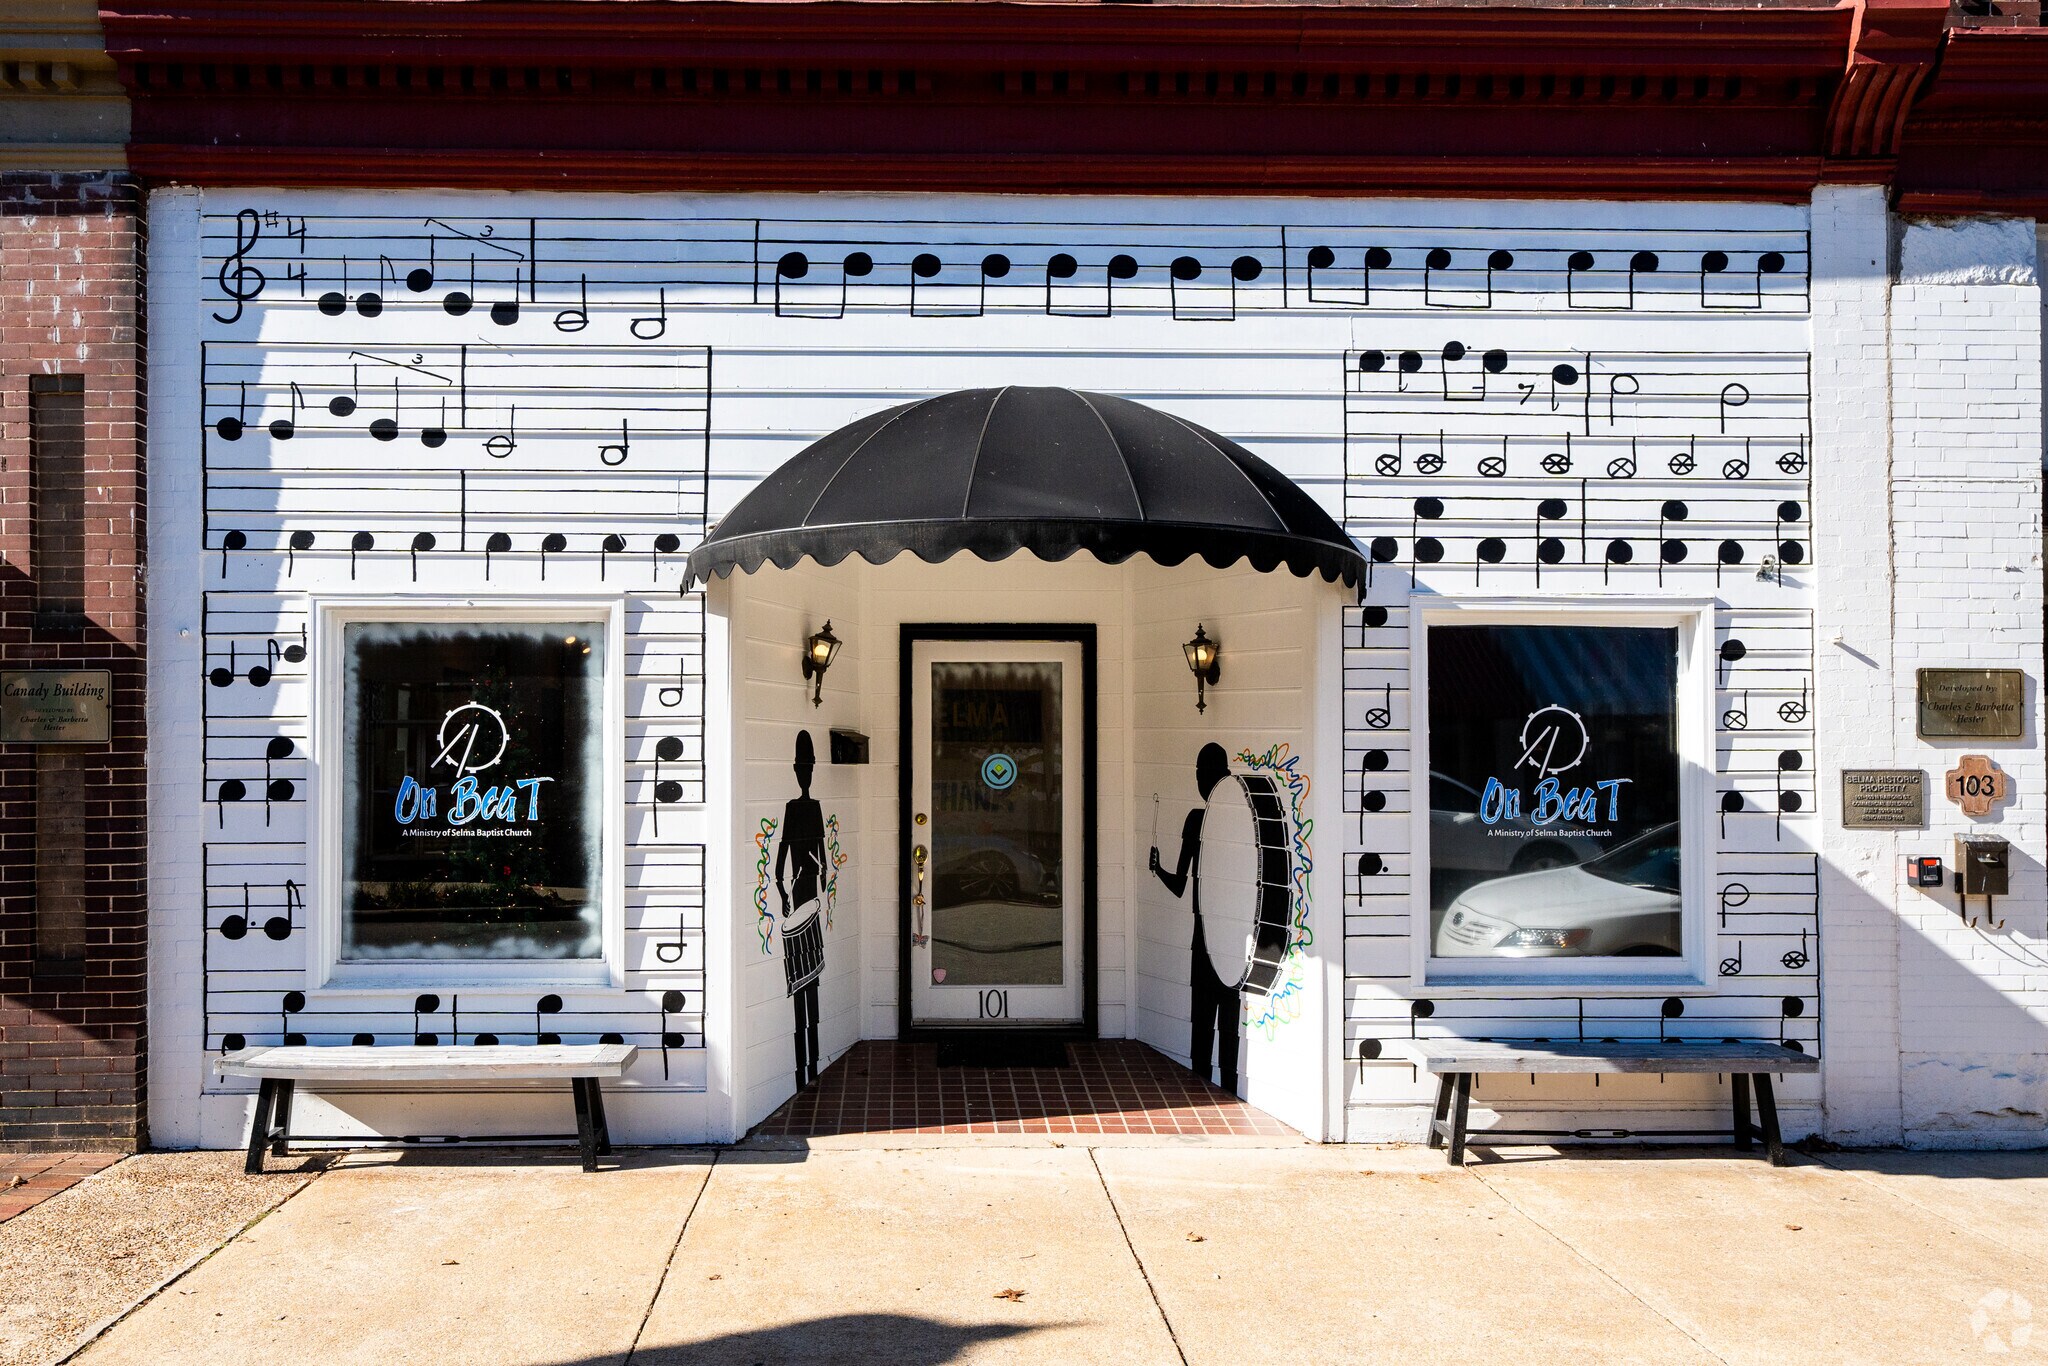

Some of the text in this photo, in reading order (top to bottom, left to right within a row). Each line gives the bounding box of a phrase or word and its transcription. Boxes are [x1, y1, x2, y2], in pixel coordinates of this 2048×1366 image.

[4, 682, 105, 701] Canady Building
[1938, 684, 1982, 693] Developed
[1927, 702, 2014, 712] Charles & Barbetta
[1956, 714, 1986, 724] Hester
[1846, 775, 1920, 784] SELMA HISTORIC
[1859, 785, 1907, 793] PROPERTY
[1955, 775, 1995, 797] 103
[394, 775, 438, 825] On
[1480, 776, 1521, 825] On
[409, 828, 441, 838] Ministry
[441, 828, 451, 836] of
[451, 828, 475, 837] Selma
[477, 828, 503, 838] Baptist
[504, 828, 532, 837] Church
[1495, 829, 1525, 839] Ministry
[1525, 829, 1534, 837] of
[1534, 829, 1557, 837] Selma
[1559, 829, 1585, 839] Baptist
[1585, 829, 1612, 837] Church
[978, 989, 1009, 1019] 101
